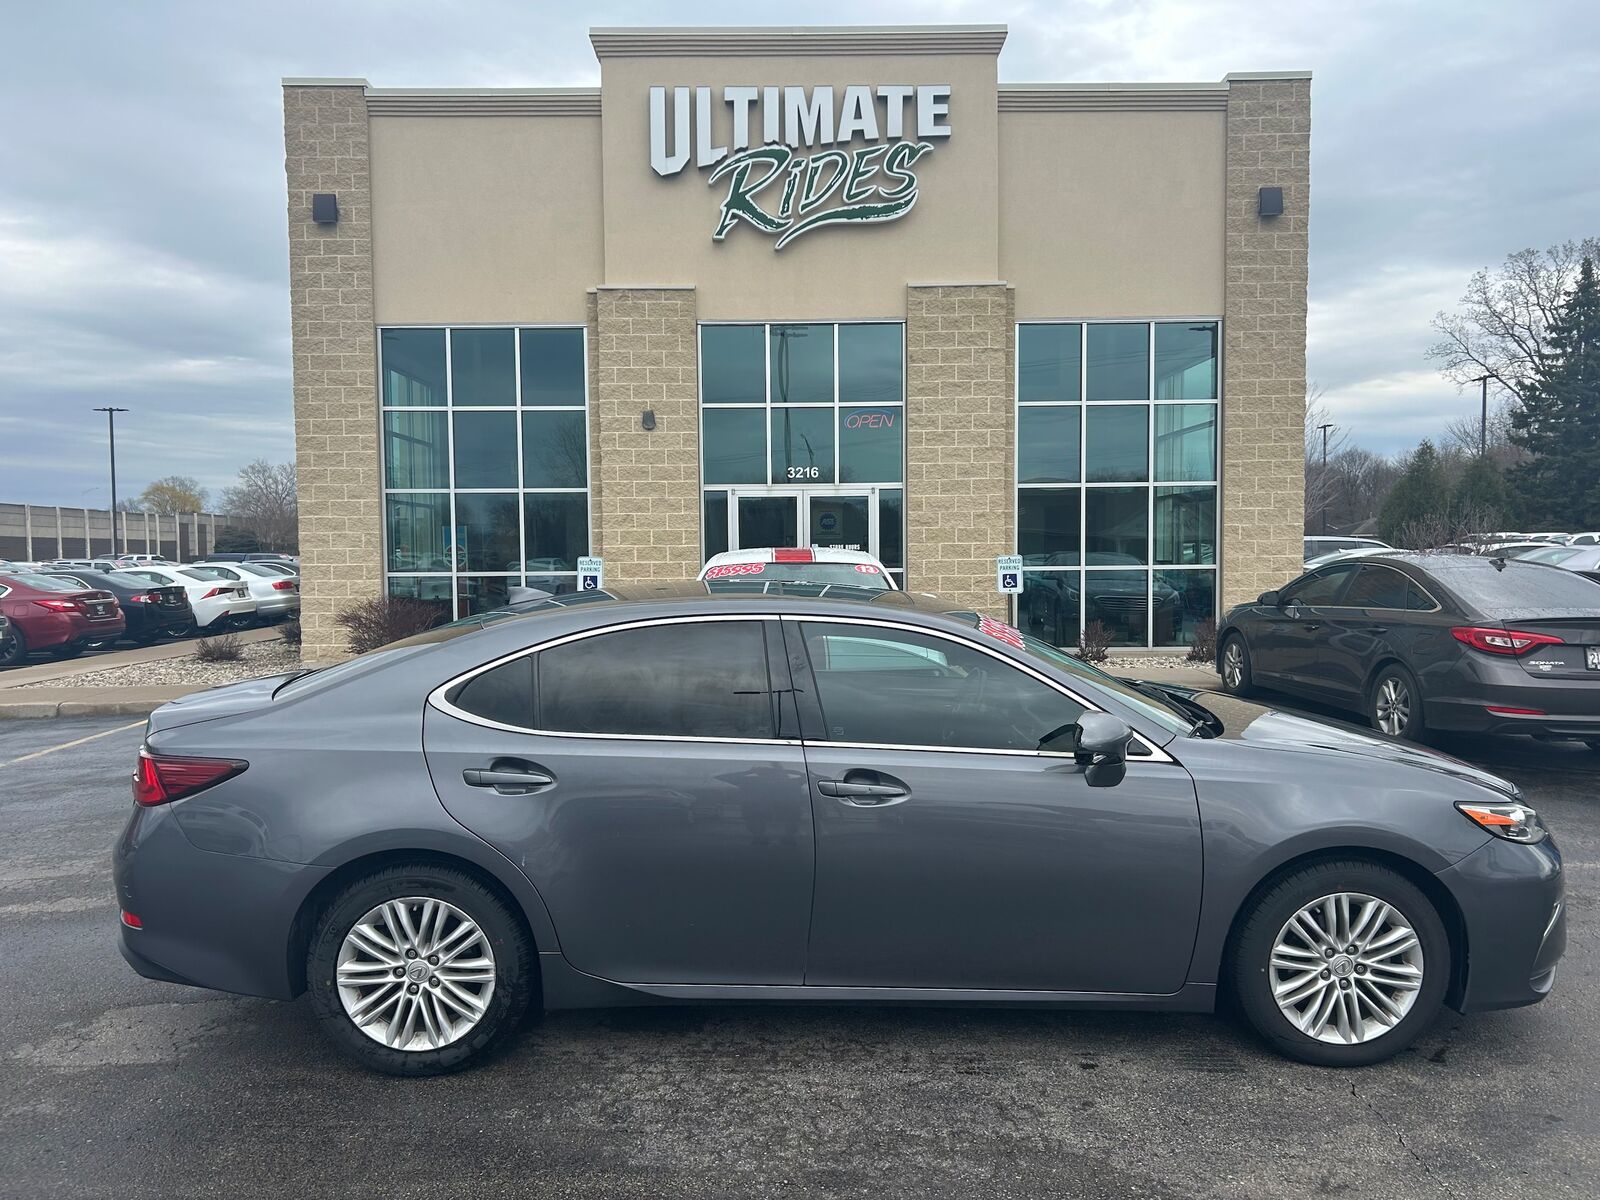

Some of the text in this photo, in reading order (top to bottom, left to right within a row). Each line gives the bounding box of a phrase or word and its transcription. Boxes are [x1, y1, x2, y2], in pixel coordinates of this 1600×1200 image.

[649, 85, 952, 176] ULTIMATE
[846, 414, 895, 428] OPEN
[787, 466, 819, 478] 3216
